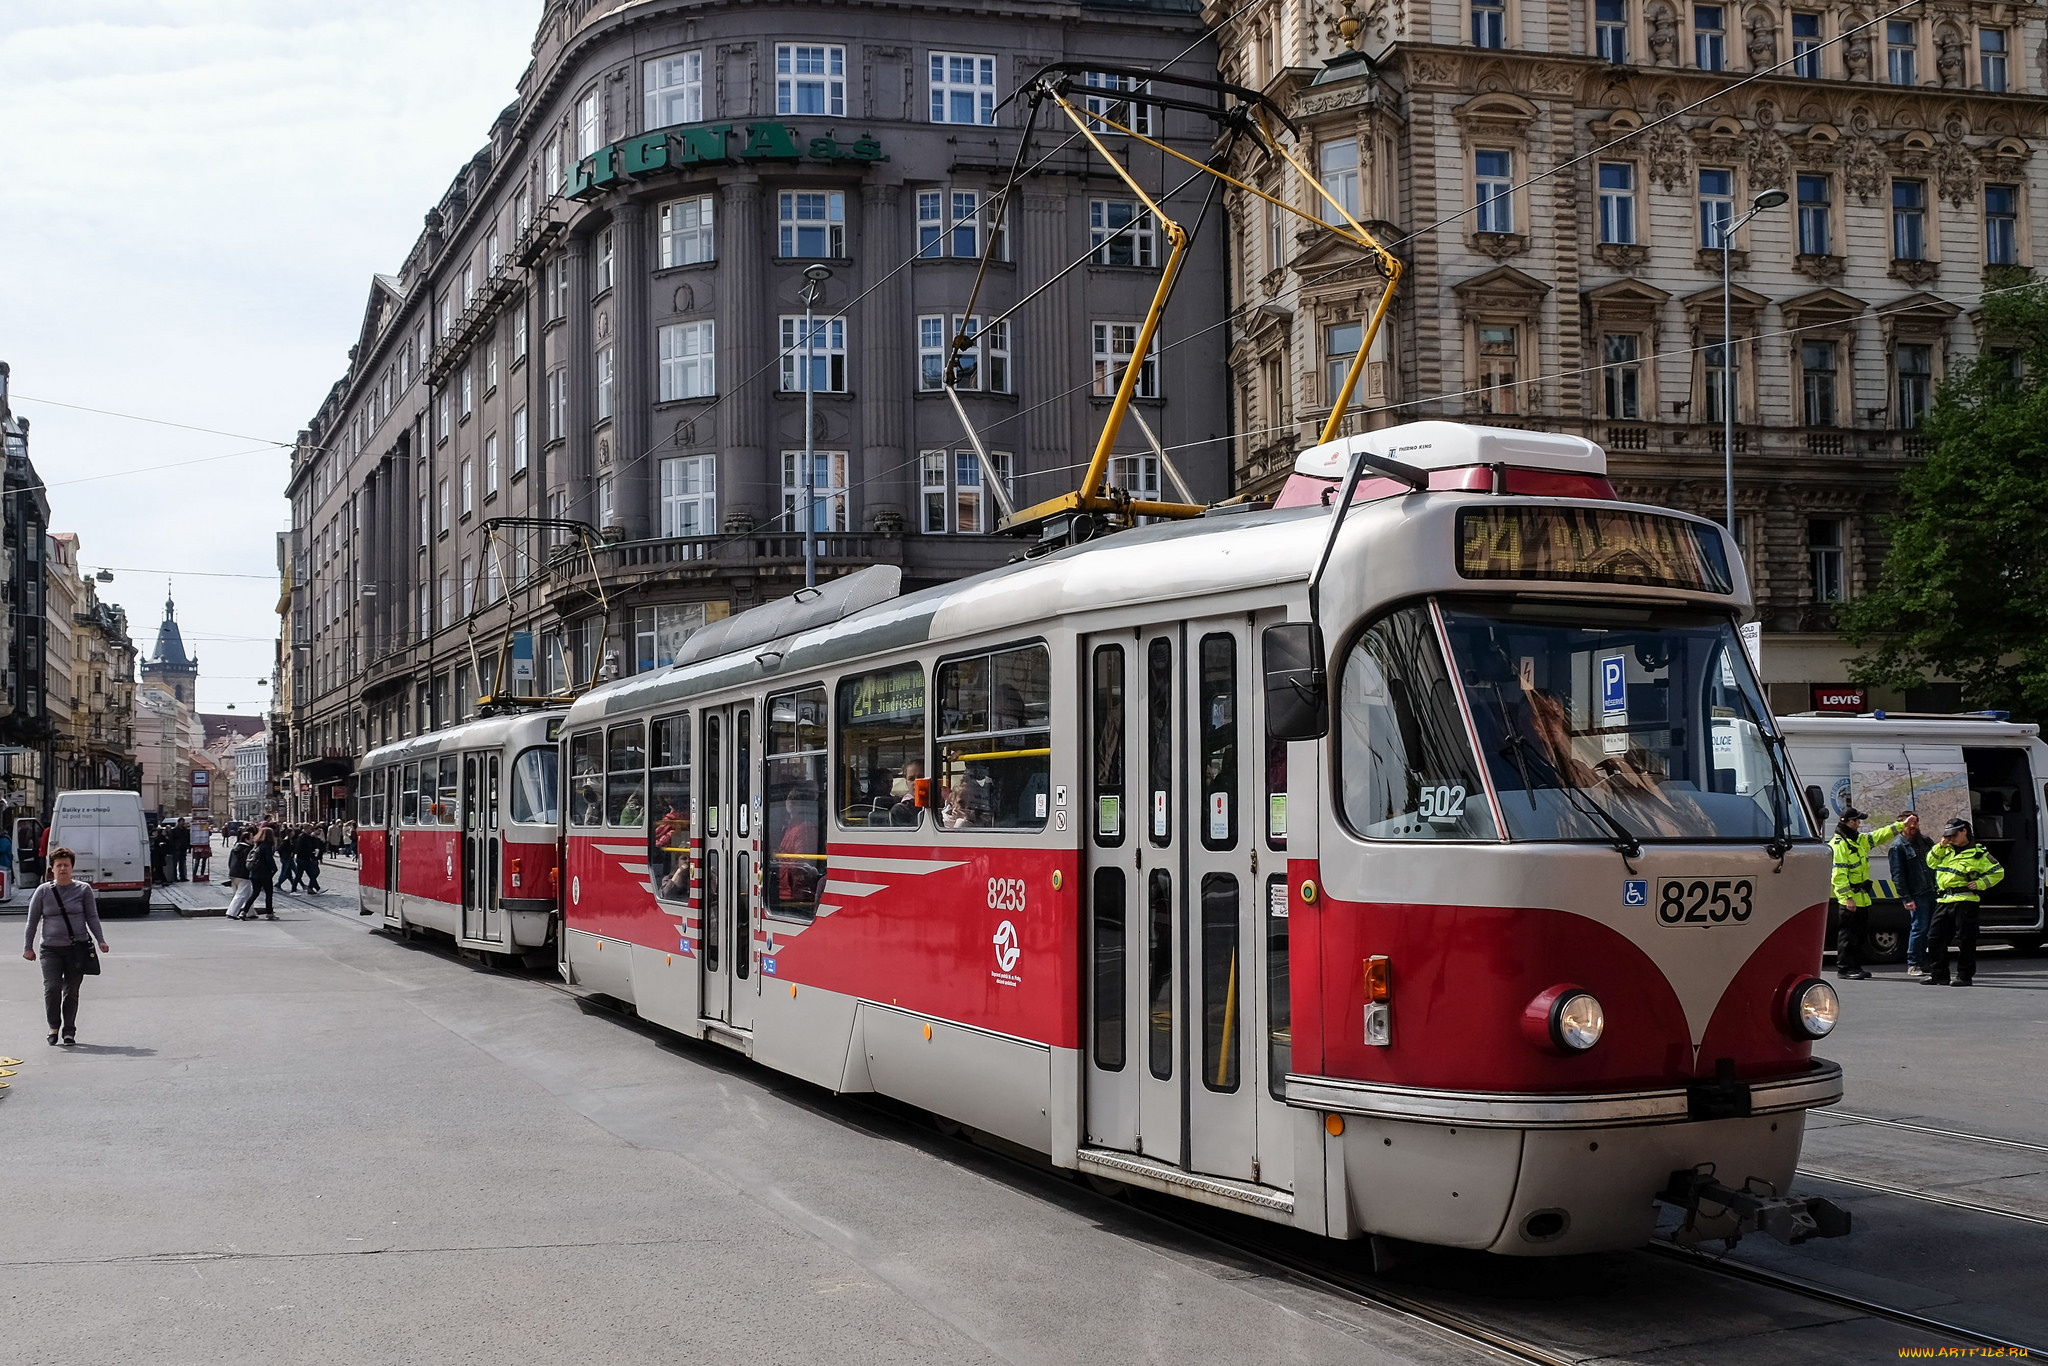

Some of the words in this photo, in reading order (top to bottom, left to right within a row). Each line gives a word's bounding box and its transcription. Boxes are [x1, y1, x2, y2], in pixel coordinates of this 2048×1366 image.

[564, 122, 801, 200] LIGNA
[1463, 516, 1520, 571] 24
[853, 678, 872, 717] 24
[1606, 663, 1620, 696] P
[1419, 785, 1465, 817] 502
[987, 877, 1026, 912] 8253
[1659, 879, 1753, 924] 8253
